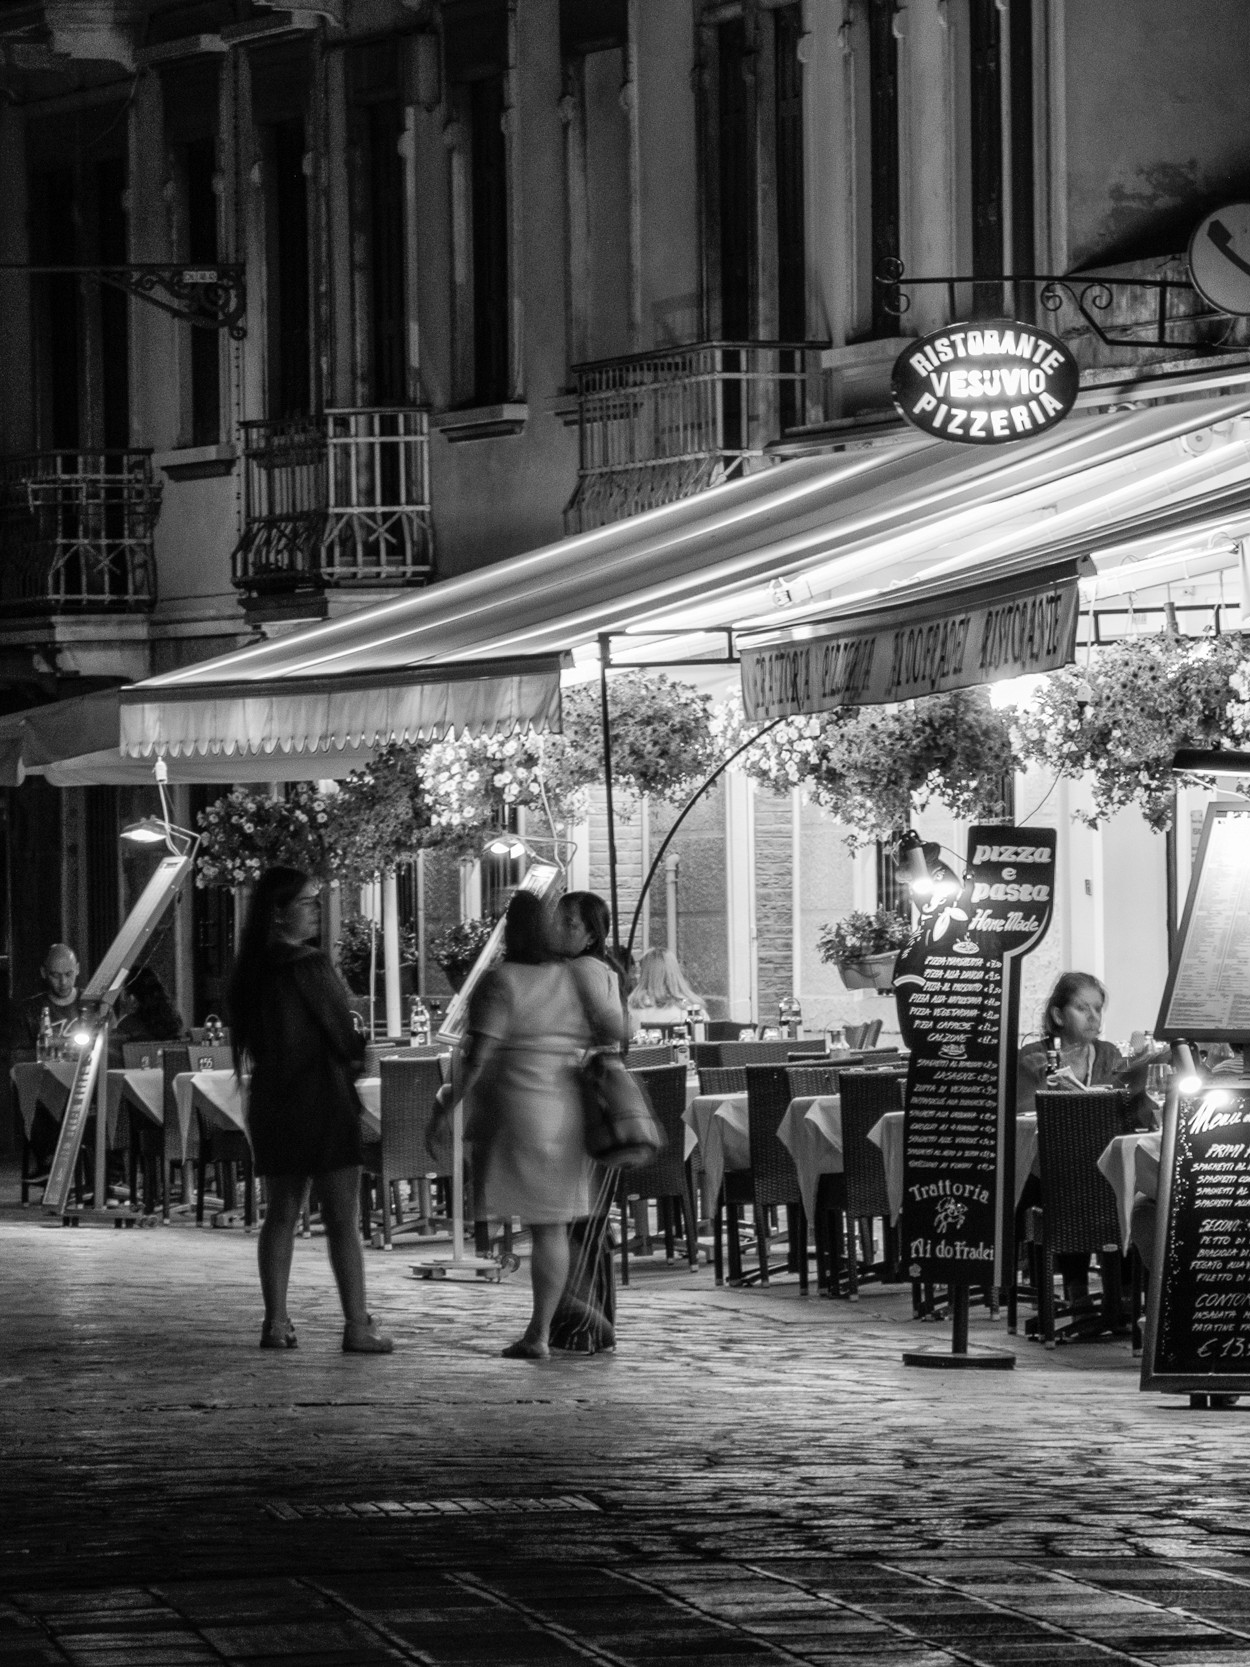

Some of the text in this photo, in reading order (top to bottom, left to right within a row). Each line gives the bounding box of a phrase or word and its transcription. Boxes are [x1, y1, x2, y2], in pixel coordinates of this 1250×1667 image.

[909, 330, 1065, 377] RISTORANTE
[930, 369, 1046, 398] VESUVIO
[912, 392, 1063, 437] PIZZERIA
[980, 594, 1063, 672] RISTORANTE
[972, 845, 1052, 865] pizza
[1001, 867, 1017, 880] e
[971, 882, 1050, 903] pasta
[968, 909, 1039, 932] Home Made
[924, 956, 947, 967] PIZZA
[923, 968, 945, 979] PIZZA
[944, 969, 961, 980] ALLA
[923, 981, 943, 992] PIZZA
[908, 993, 930, 1003] PIZZA
[930, 994, 948, 1004] ALLA
[909, 1006, 932, 1016] PIZZA
[932, 1007, 980, 1018] VEGETARIANA
[913, 1020, 934, 1029] PIZZA
[936, 1021, 976, 1030] CAPRESE
[927, 1032, 973, 1043] CALZONE
[933, 1071, 978, 1081] LASAGNE
[1205, 1143, 1245, 1158] PRIMI
[1191, 1162, 1233, 1172] SPAGHETTI
[1234, 1162, 1247, 1171] AL
[1196, 1174, 1237, 1184] SPAGHETTI
[908, 1179, 990, 1204] Trattoria
[1195, 1187, 1235, 1196] SPAGHETTI
[1235, 1186, 1249, 1196] AL
[1194, 1199, 1233, 1209] SPAGHETTI
[1200, 1235, 1231, 1245] PETTO
[1235, 1236, 1245, 1245] DI
[910, 1238, 994, 1261] Ai do Fradei
[1197, 1248, 1239, 1258] BRACIOLA
[1239, 1248, 1249, 1257] DI
[1189, 1260, 1223, 1271] FEGATO
[1226, 1261, 1246, 1270] ALLA
[1196, 1273, 1233, 1283] FILETTO
[1236, 1273, 1246, 1282] DI
[1192, 1310, 1237, 1320] INSALATA
[1192, 1323, 1235, 1332] PATATINE
[1197, 1337, 1218, 1358] €
